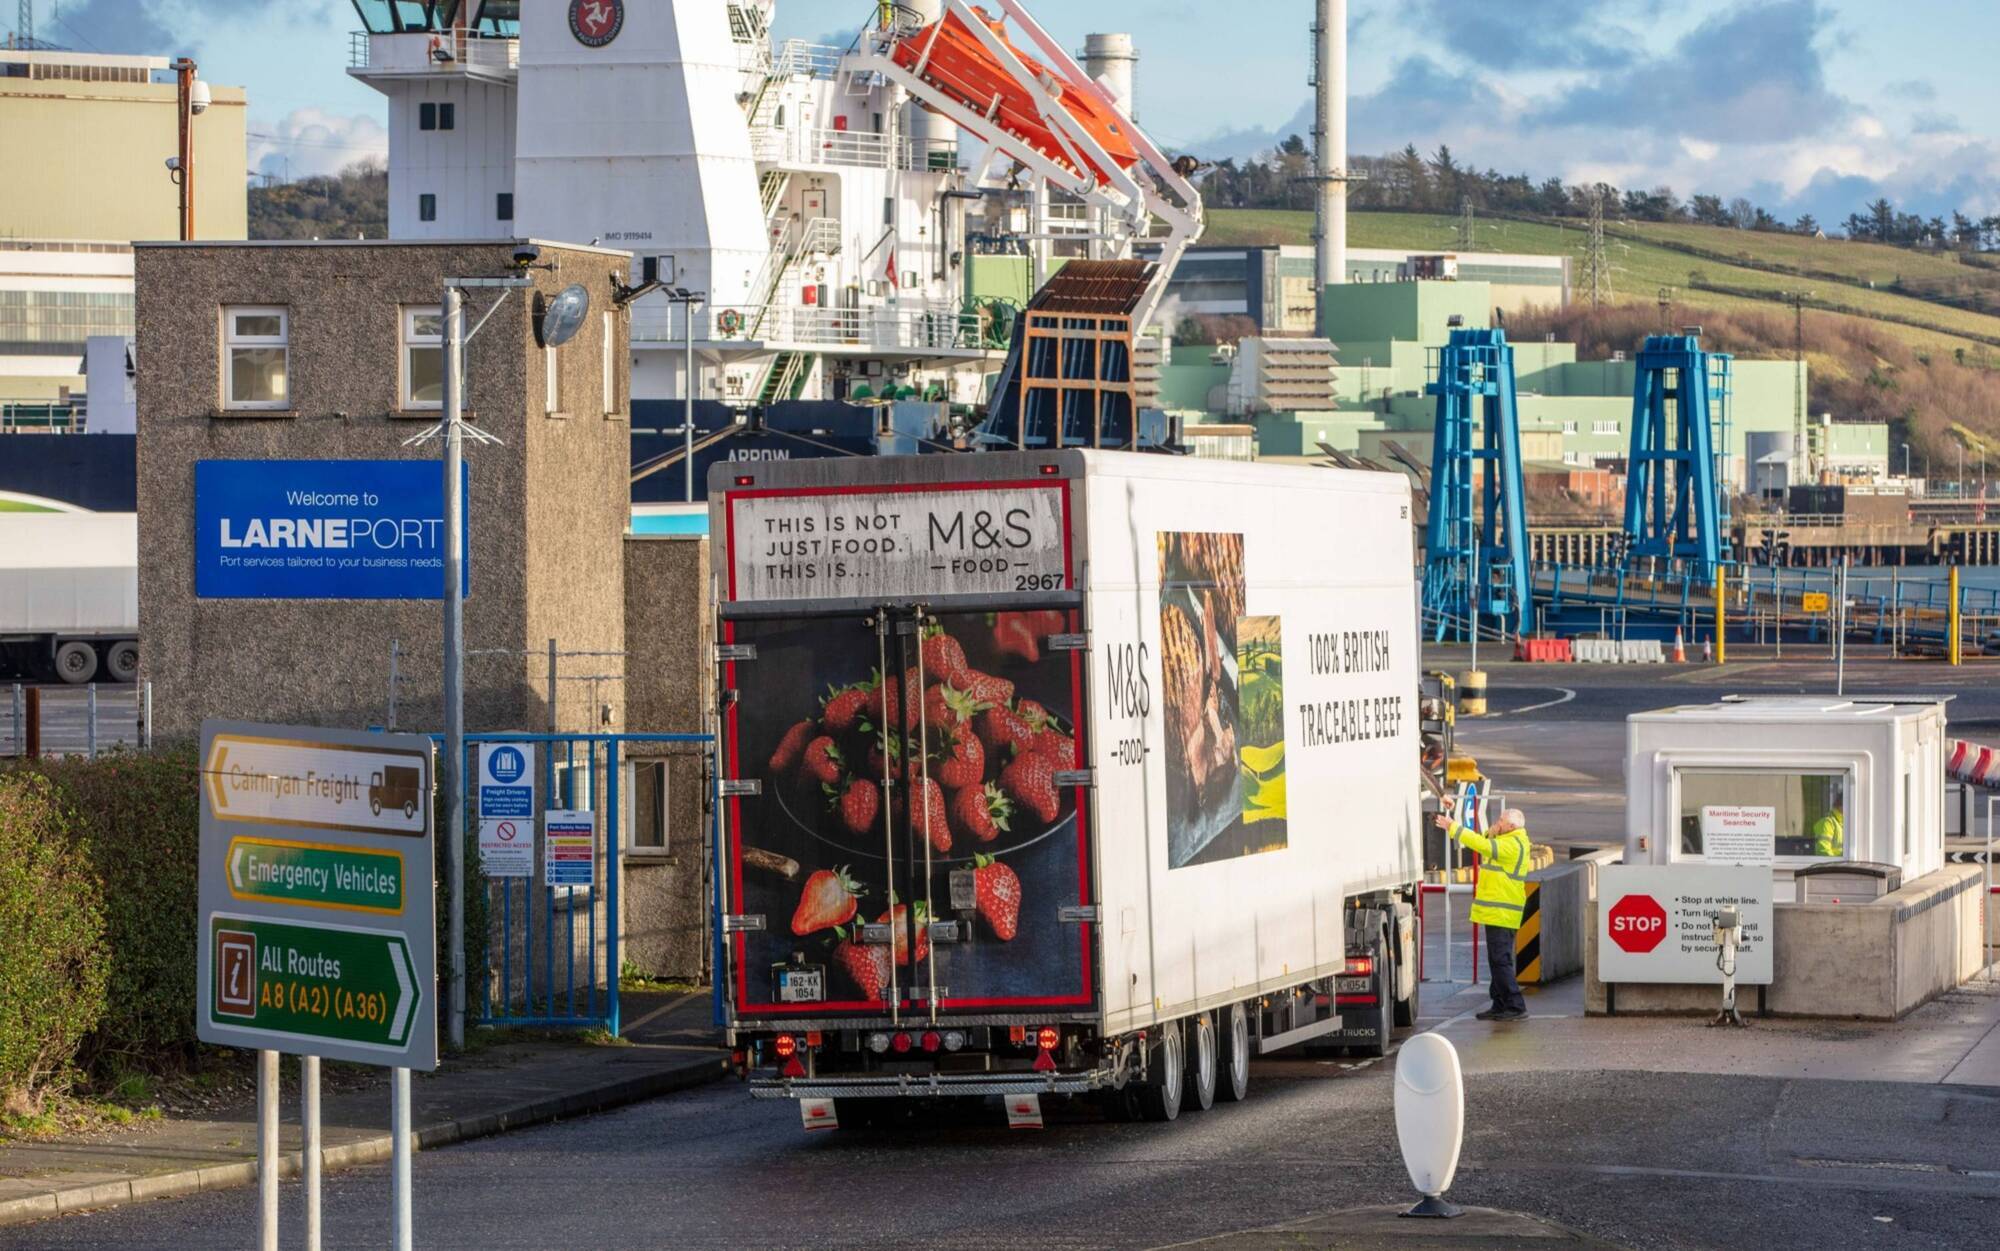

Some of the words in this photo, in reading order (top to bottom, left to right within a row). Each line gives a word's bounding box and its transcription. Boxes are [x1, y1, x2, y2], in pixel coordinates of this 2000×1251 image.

[605, 231, 621, 240] IMO
[728, 449, 789, 463] ARROW
[286, 490, 359, 506] Welcome
[363, 491, 379, 506] to
[765, 516, 815, 533] THIS
[825, 516, 845, 532] IS
[856, 514, 901, 531] NOT
[928, 508, 1032, 551] M&S
[220, 518, 444, 549] LARNEPORT
[766, 540, 821, 557] JUST
[832, 538, 904, 554] FOOD.
[220, 555, 241, 567] Port
[243, 556, 285, 567] services
[287, 556, 323, 567] tailored
[326, 557, 336, 567] to
[338, 558, 361, 569] your
[362, 556, 407, 567] business
[766, 563, 816, 580] THIS
[827, 562, 870, 578] IS...
[1015, 574, 1064, 591] 2967
[1309, 633, 1339, 675] 100%
[1343, 630, 1390, 673] BRITISH
[1107, 641, 1150, 720] M&S
[1299, 699, 1371, 748] TRACEABLE
[1374, 696, 1401, 739] BEEF
[230, 763, 301, 799] Cairnryan
[306, 770, 359, 804] Freight
[486, 789, 505, 797] Freight
[1741, 810, 1770, 819] Security
[248, 855, 329, 893] Emergency
[334, 863, 396, 895] Vehicles
[1681, 896, 1702, 906] Stop
[1704, 897, 1713, 905] at
[1715, 896, 1739, 905] white
[1741, 896, 1760, 905] line.
[1682, 909, 1701, 917] Turn
[1614, 916, 1662, 931] STOP
[1681, 922, 1694, 930] Do
[1696, 922, 1711, 930] not
[1681, 944, 1692, 953] by
[261, 945, 283, 973] All
[288, 948, 341, 980] Routes
[795, 987, 814, 999] 1054
[261, 981, 285, 1009] A8
[290, 981, 329, 1018] (A2)
[335, 987, 388, 1025] (A36)
[1343, 1028, 1376, 1037] TRUCKS
